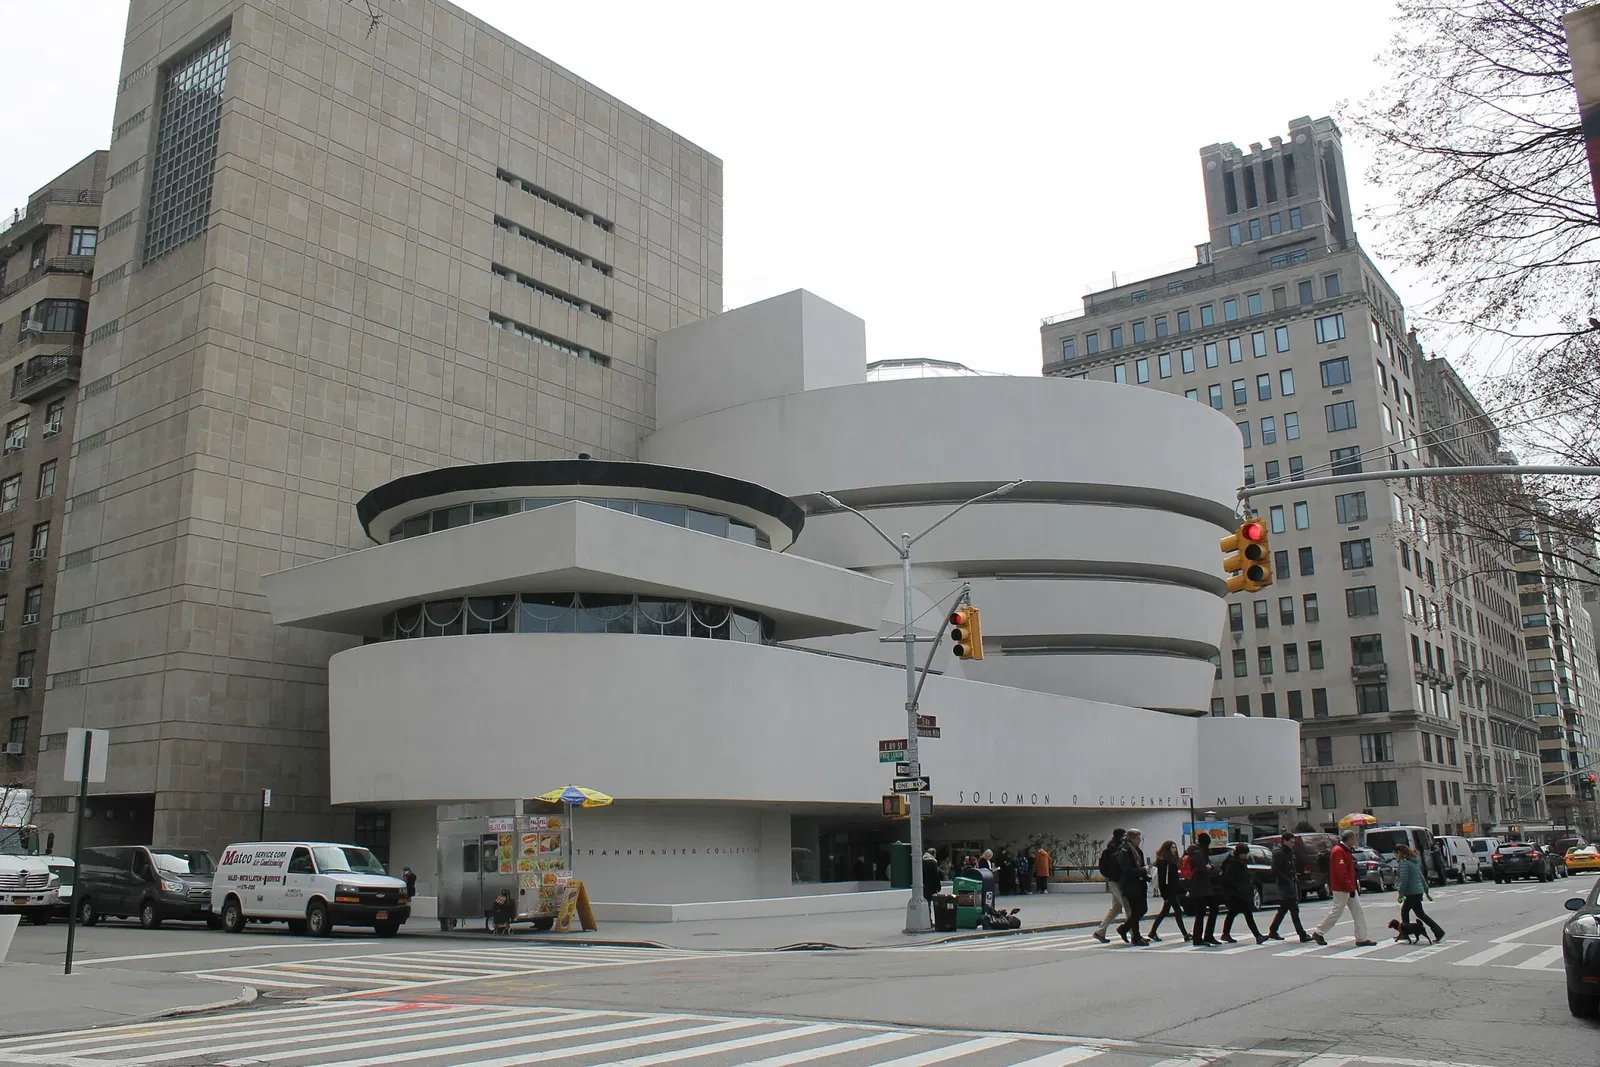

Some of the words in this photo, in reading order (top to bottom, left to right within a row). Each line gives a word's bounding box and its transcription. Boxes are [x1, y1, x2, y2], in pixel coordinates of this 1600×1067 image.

[889, 742, 896, 750] 89
[959, 790, 1050, 805] SOLOMON
[1098, 795, 1188, 807] GUGGENHEIM
[1216, 795, 1295, 806] MUSEUM
[222, 850, 253, 866] Matco
[255, 851, 274, 859] SERVICE
[576, 848, 697, 856] THANNHAUSER
